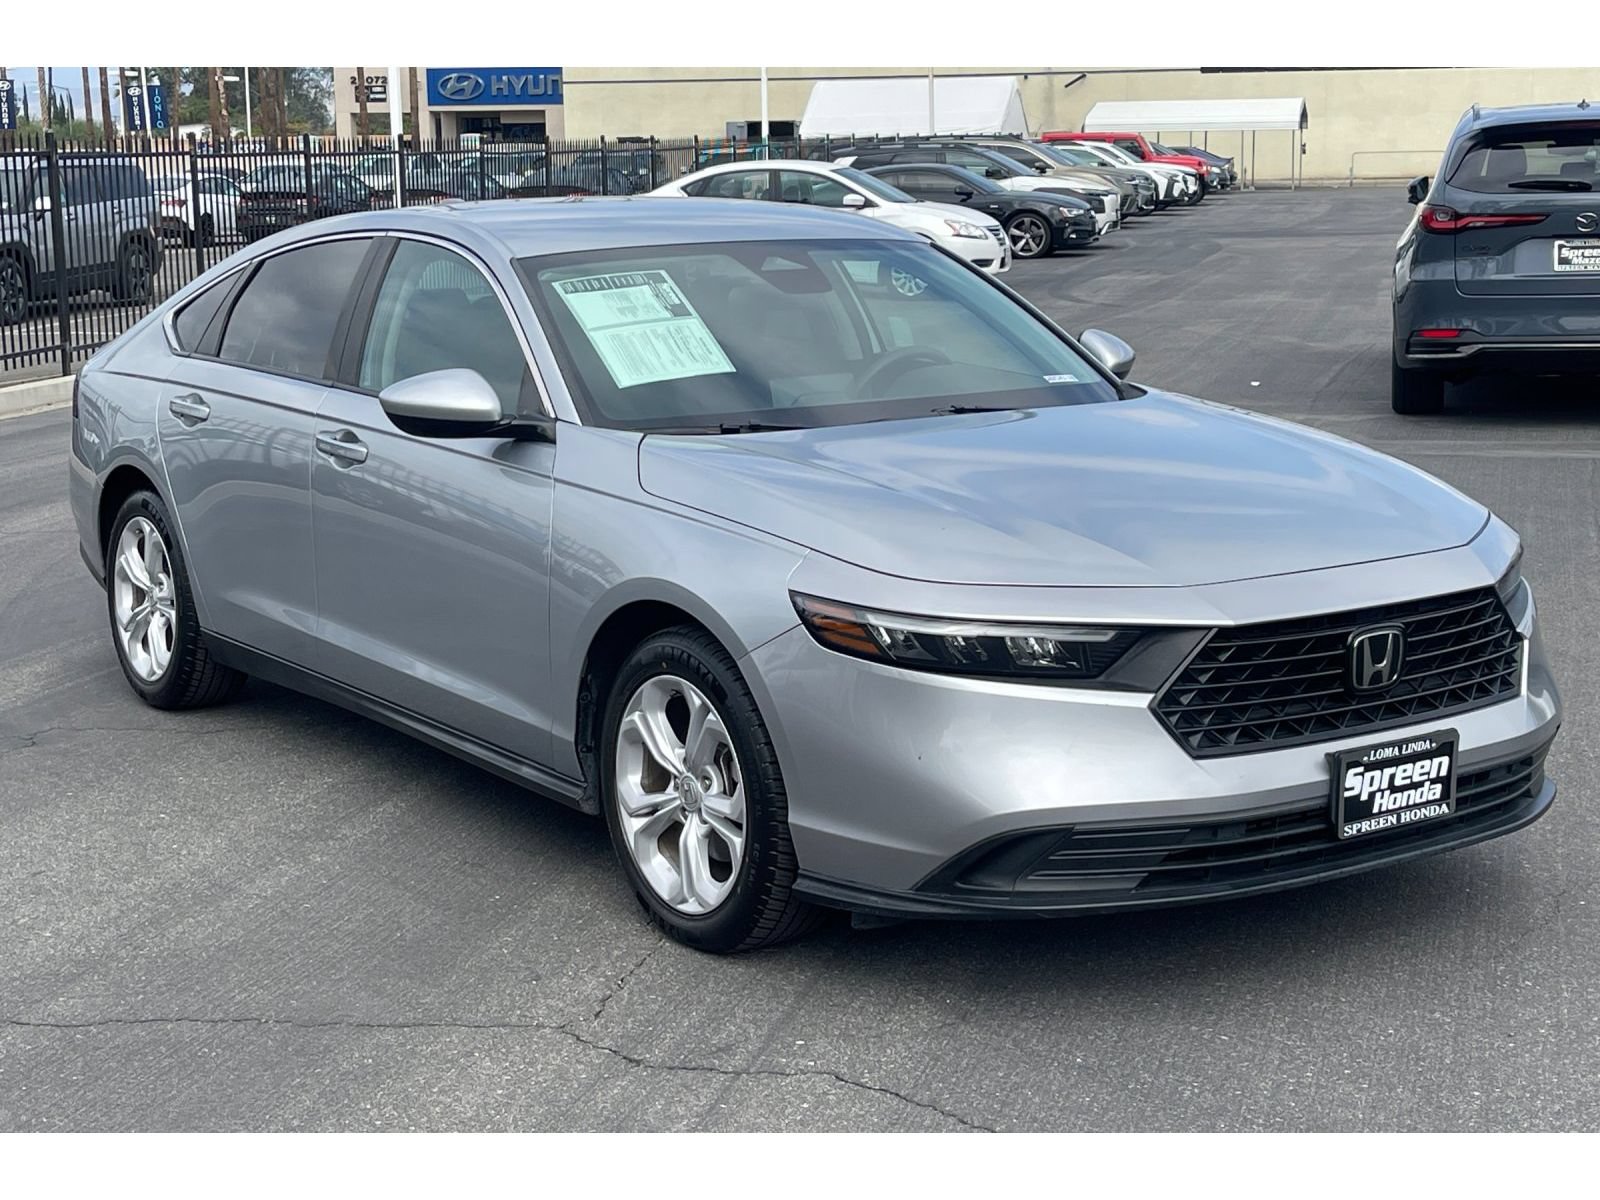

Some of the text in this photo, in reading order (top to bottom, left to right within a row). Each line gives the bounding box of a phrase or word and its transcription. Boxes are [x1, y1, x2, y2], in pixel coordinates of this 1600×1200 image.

[350, 76, 388, 85] 2072
[491, 75, 563, 96] HYUN
[153, 87, 164, 129] IONIQ
[1369, 739, 1431, 761] LOMA LINDA
[1343, 755, 1450, 801] Spreen
[1372, 780, 1442, 814] Honda
[1343, 803, 1449, 837] SPREEN HONDA
